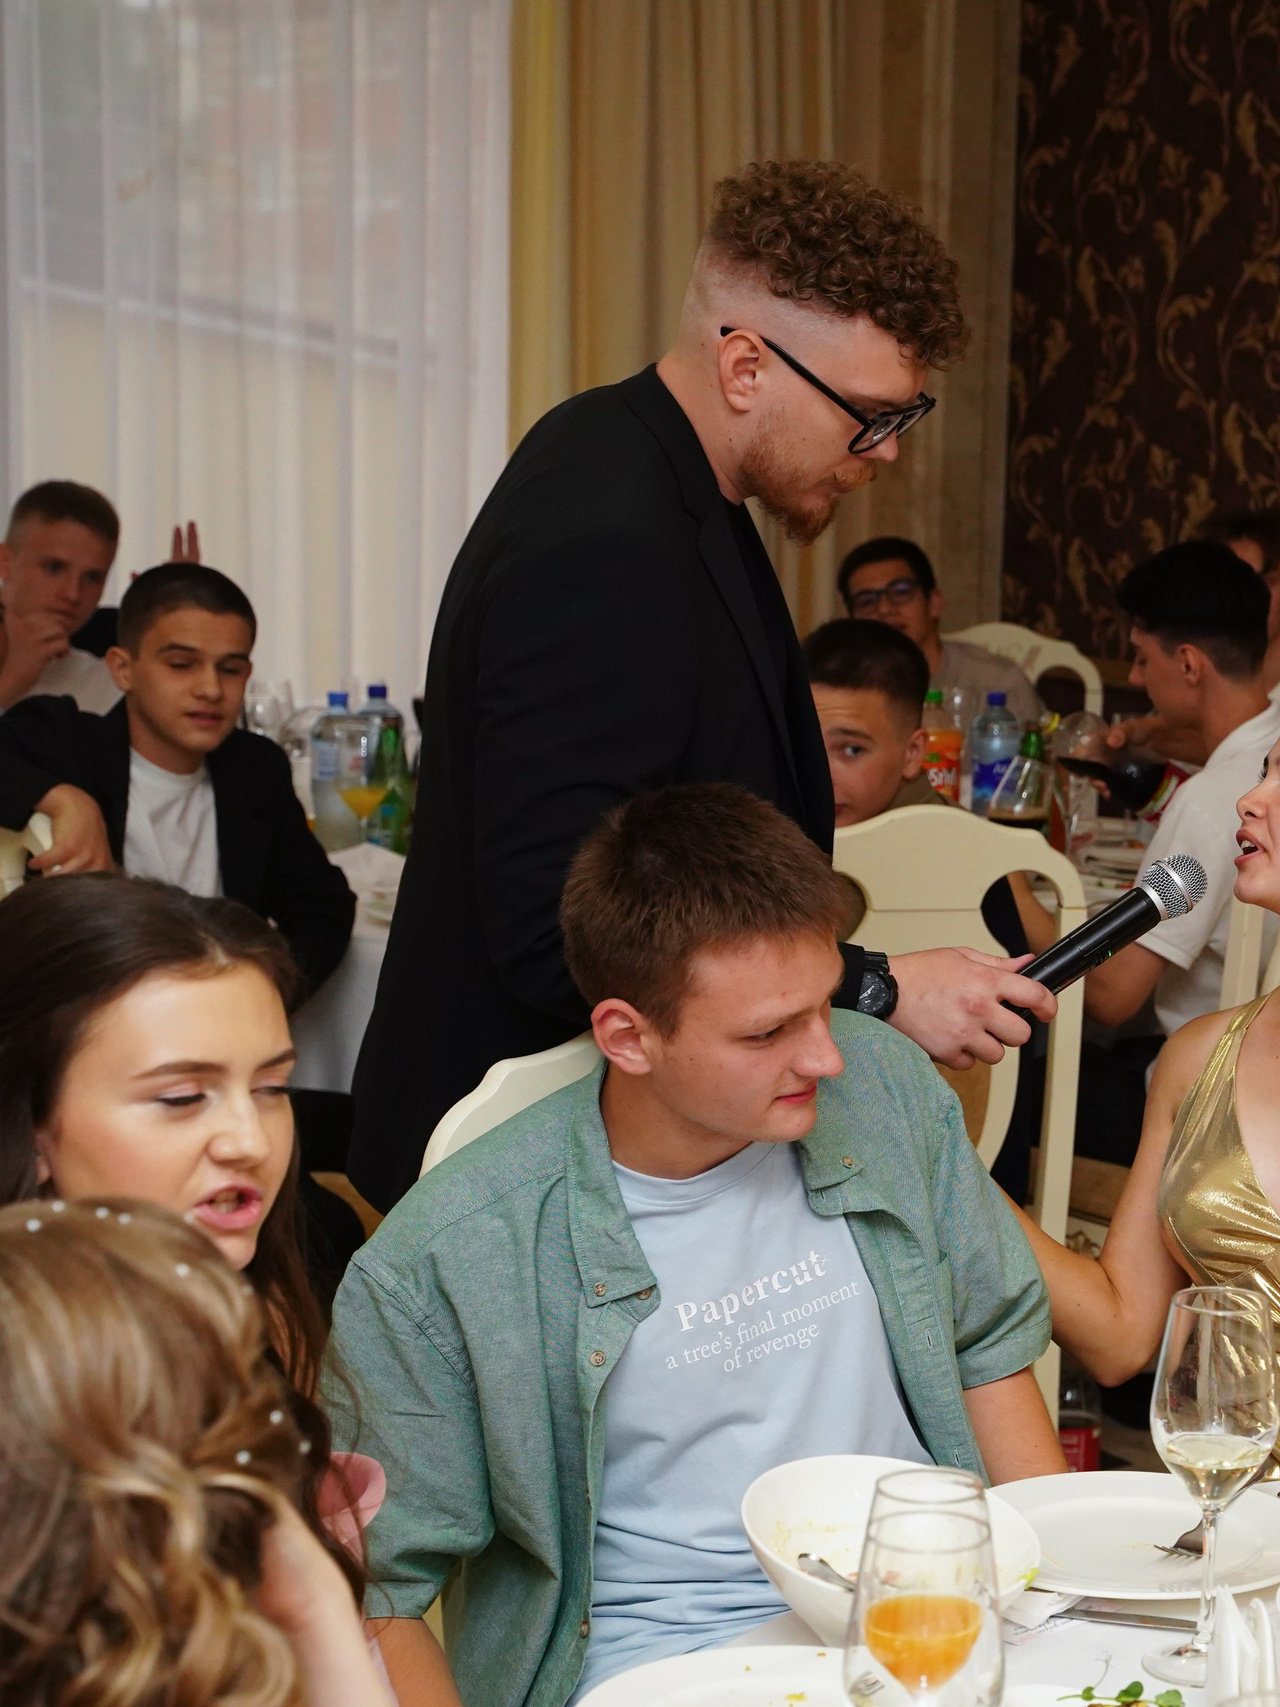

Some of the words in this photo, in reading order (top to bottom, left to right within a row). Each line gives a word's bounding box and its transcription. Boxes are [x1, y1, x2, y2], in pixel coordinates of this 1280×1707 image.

[665, 1355, 679, 1370] a
[736, 1310, 777, 1345] final
[781, 1280, 861, 1326] moment
[673, 1250, 827, 1332] Papercut
[723, 1346, 742, 1373] of
[746, 1323, 820, 1364] revenge
